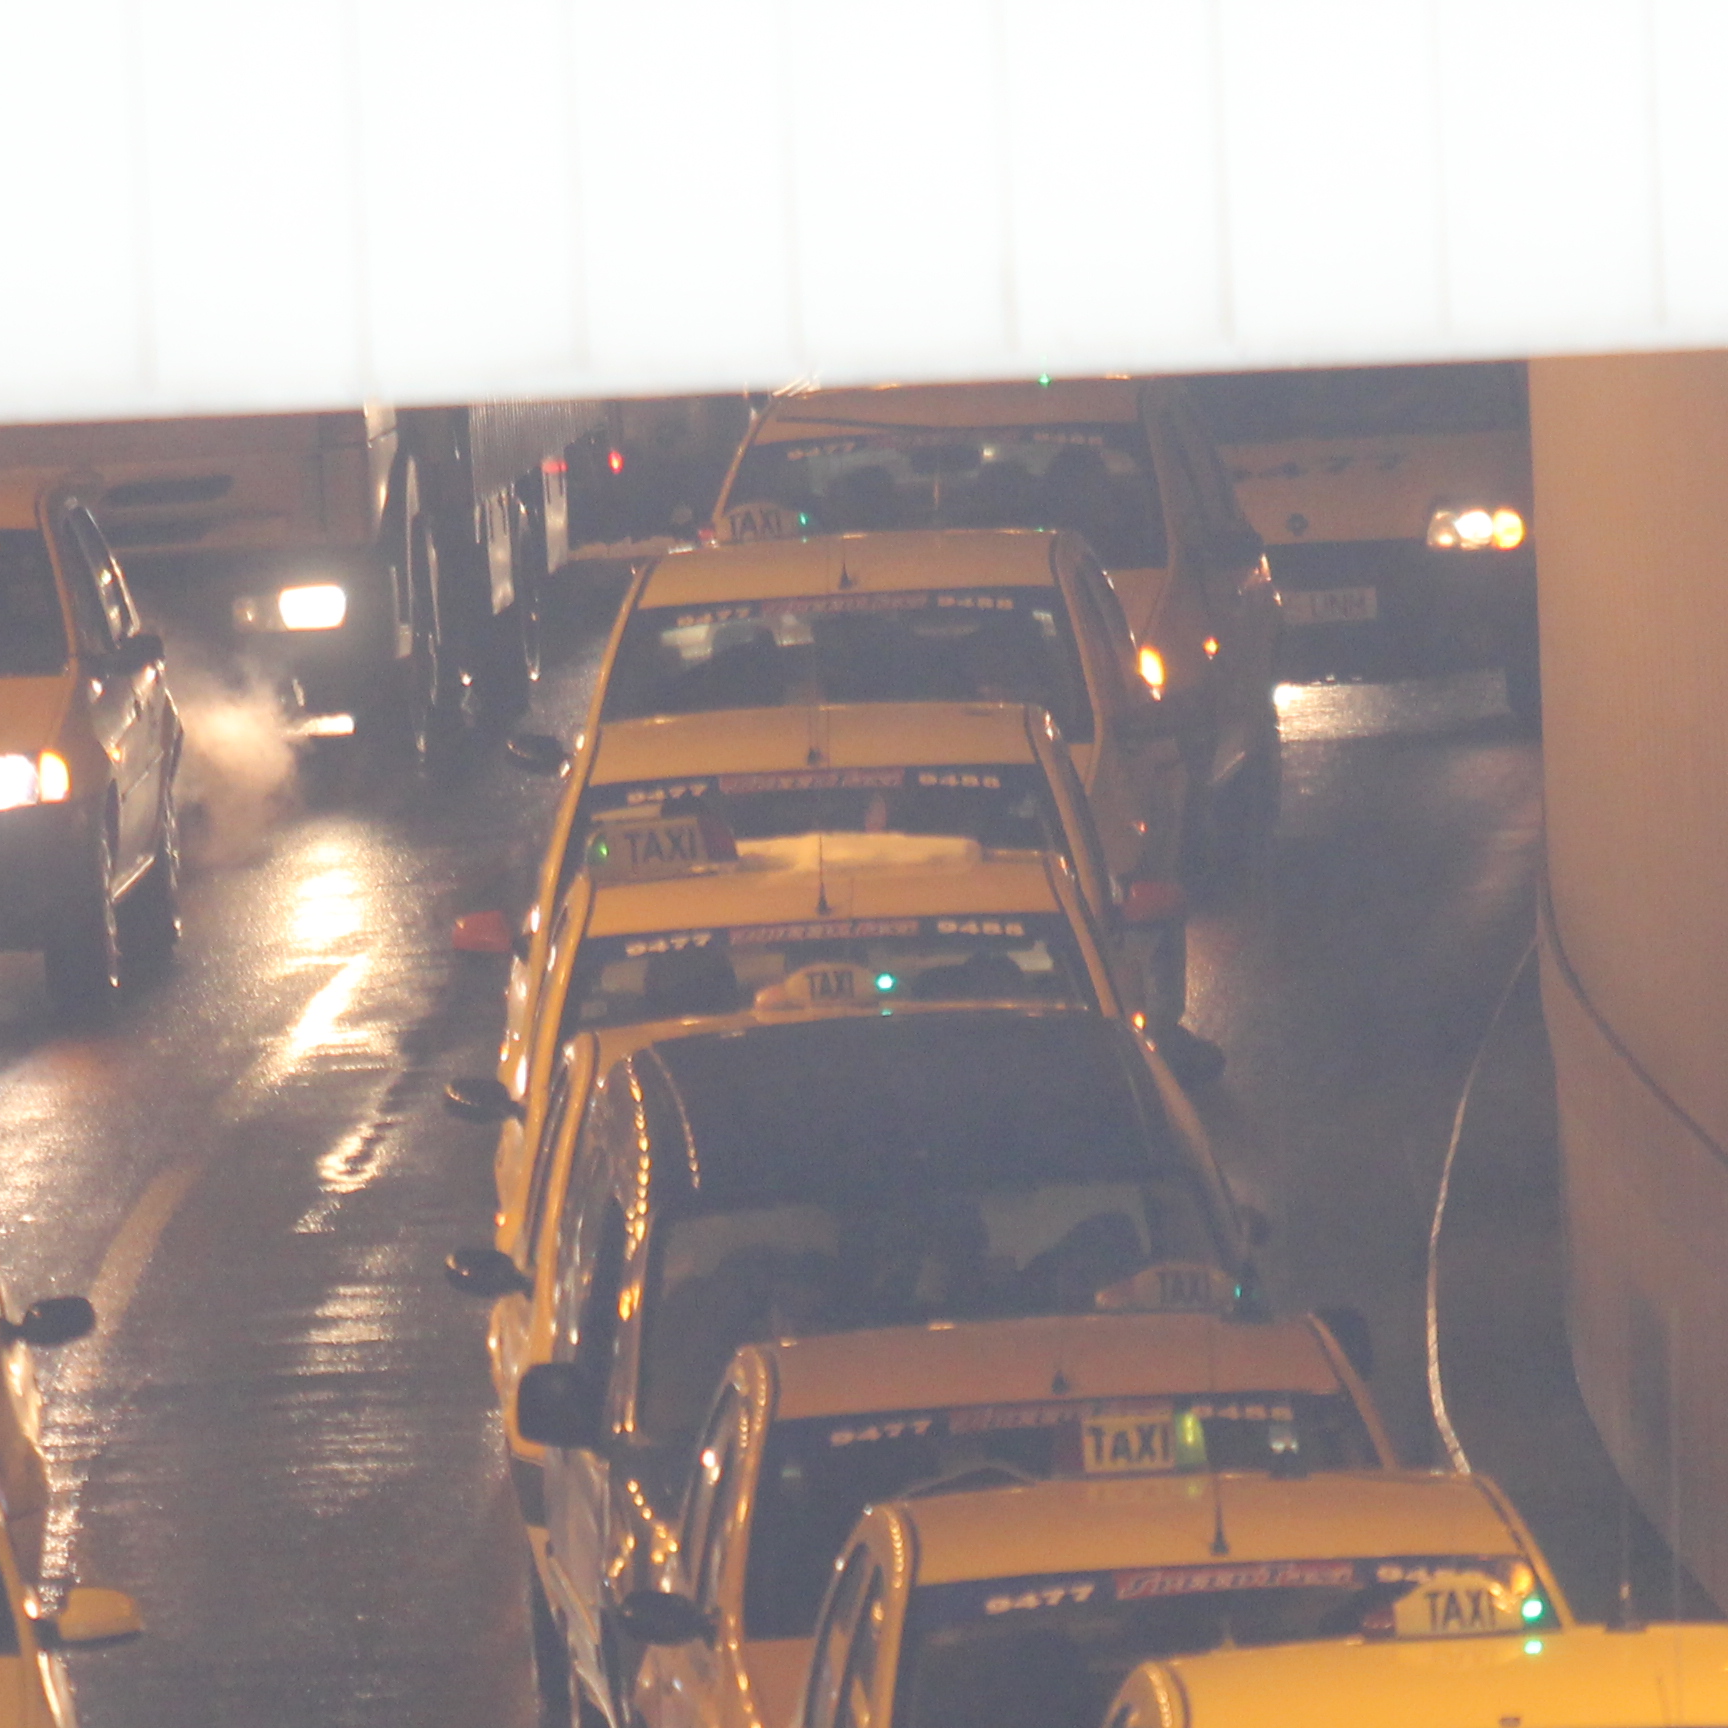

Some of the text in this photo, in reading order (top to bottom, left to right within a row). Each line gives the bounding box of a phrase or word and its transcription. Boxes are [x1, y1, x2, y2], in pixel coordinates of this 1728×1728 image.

[624, 825, 697, 864] TAXI
[1092, 1425, 1169, 1464] TAXI
[1428, 1590, 1495, 1631] TAXI
